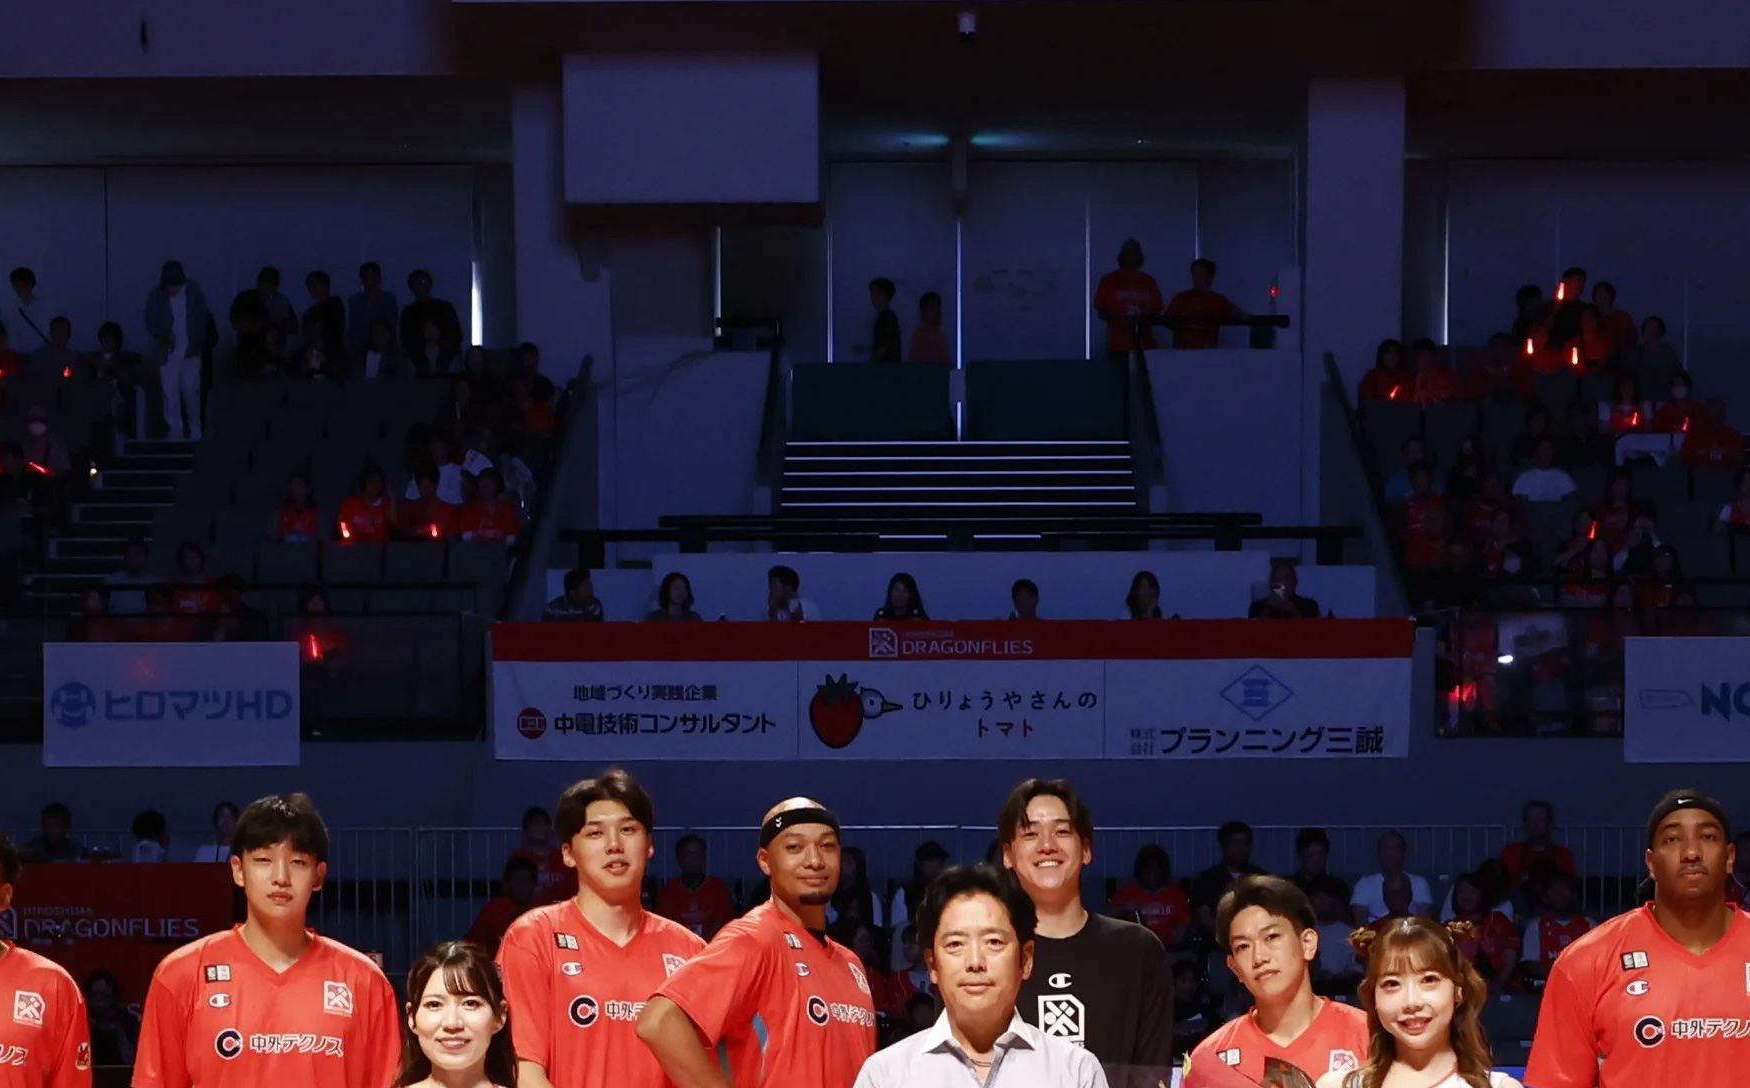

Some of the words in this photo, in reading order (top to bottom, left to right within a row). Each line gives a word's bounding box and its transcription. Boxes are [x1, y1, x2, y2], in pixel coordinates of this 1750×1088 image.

[902, 639, 1034, 655] DRAGONFLIES
[104, 689, 294, 721] ヒロマツHD
[912, 690, 1098, 710] ひりょうやさんの
[554, 713, 776, 735] 中電技術コンサルタント
[977, 718, 1034, 738] トマト
[1160, 726, 1384, 754] プランニング三誠
[250, 1033, 344, 1058] 中外テクノス
